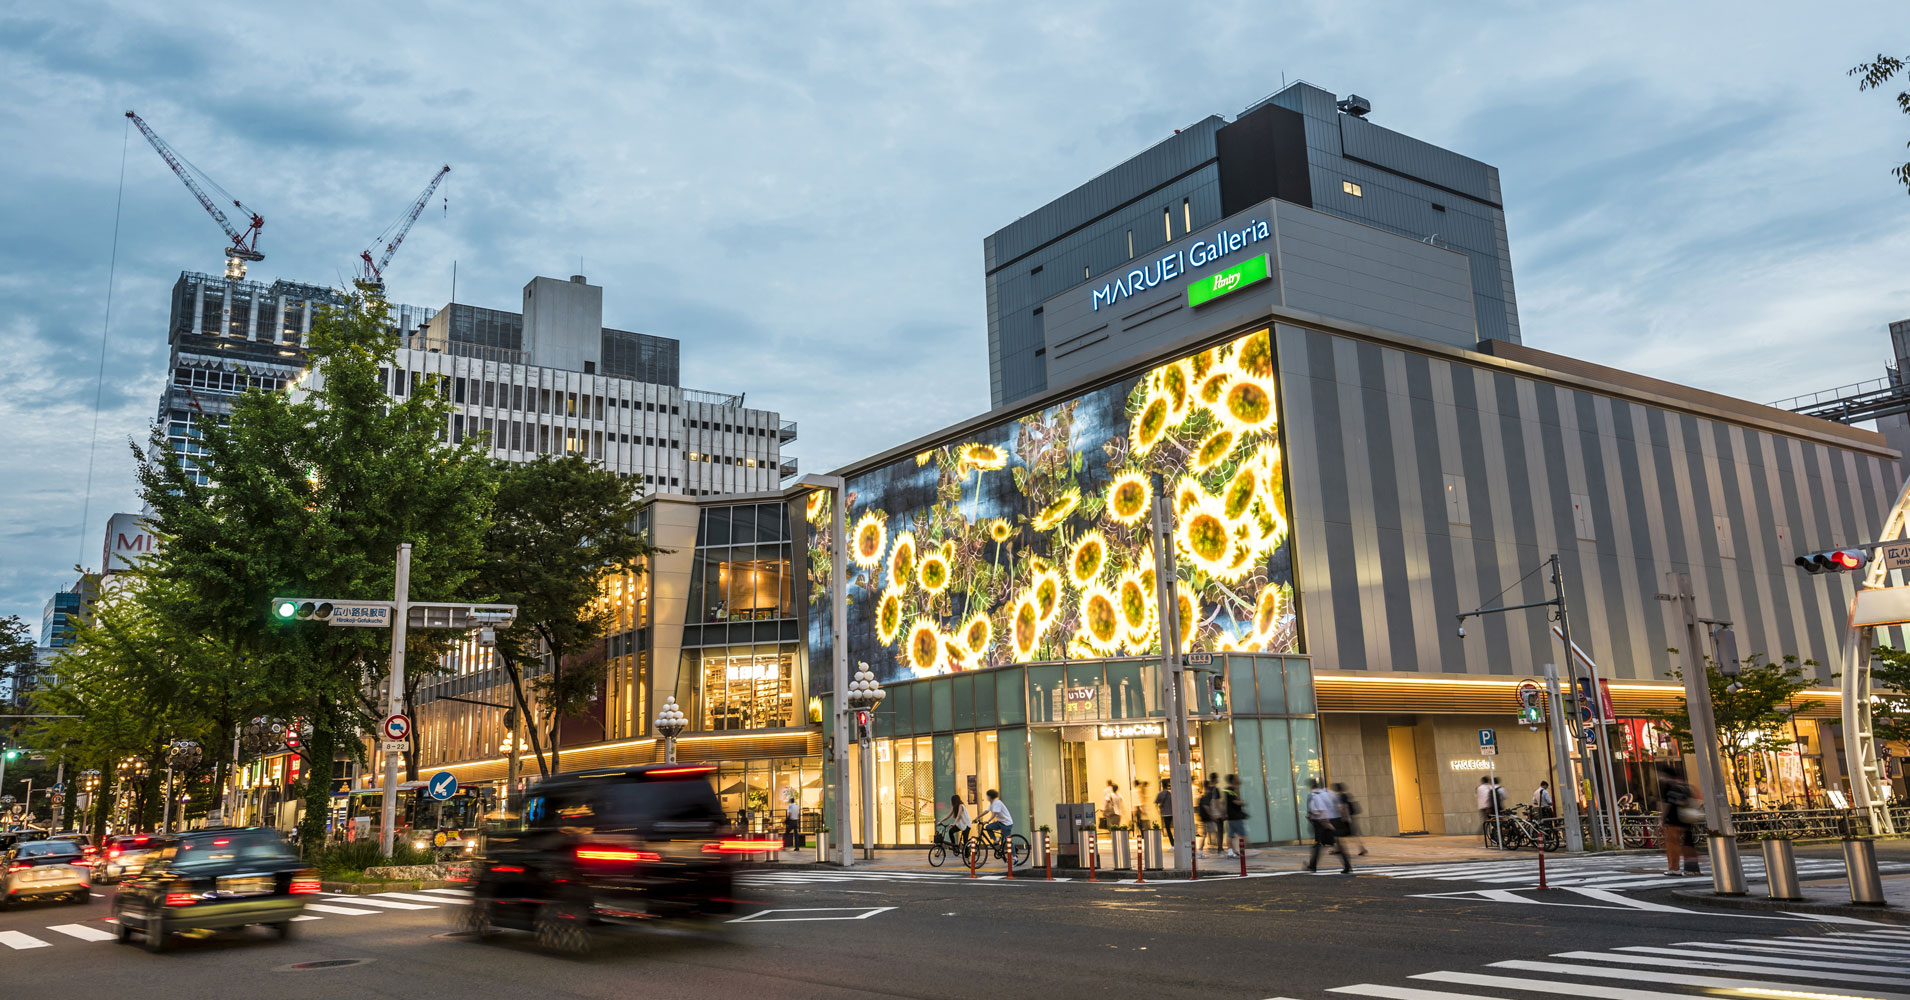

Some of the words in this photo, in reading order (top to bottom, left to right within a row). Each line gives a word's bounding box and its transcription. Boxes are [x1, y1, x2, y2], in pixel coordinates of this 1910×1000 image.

[1092, 250, 1185, 311] MARUEI
[1189, 219, 1271, 267] Galleria
[1212, 272, 1241, 291] Pantry
[118, 533, 158, 552] MI
[1888, 547, 1910, 559] 広小
[1482, 731, 1491, 744] P
